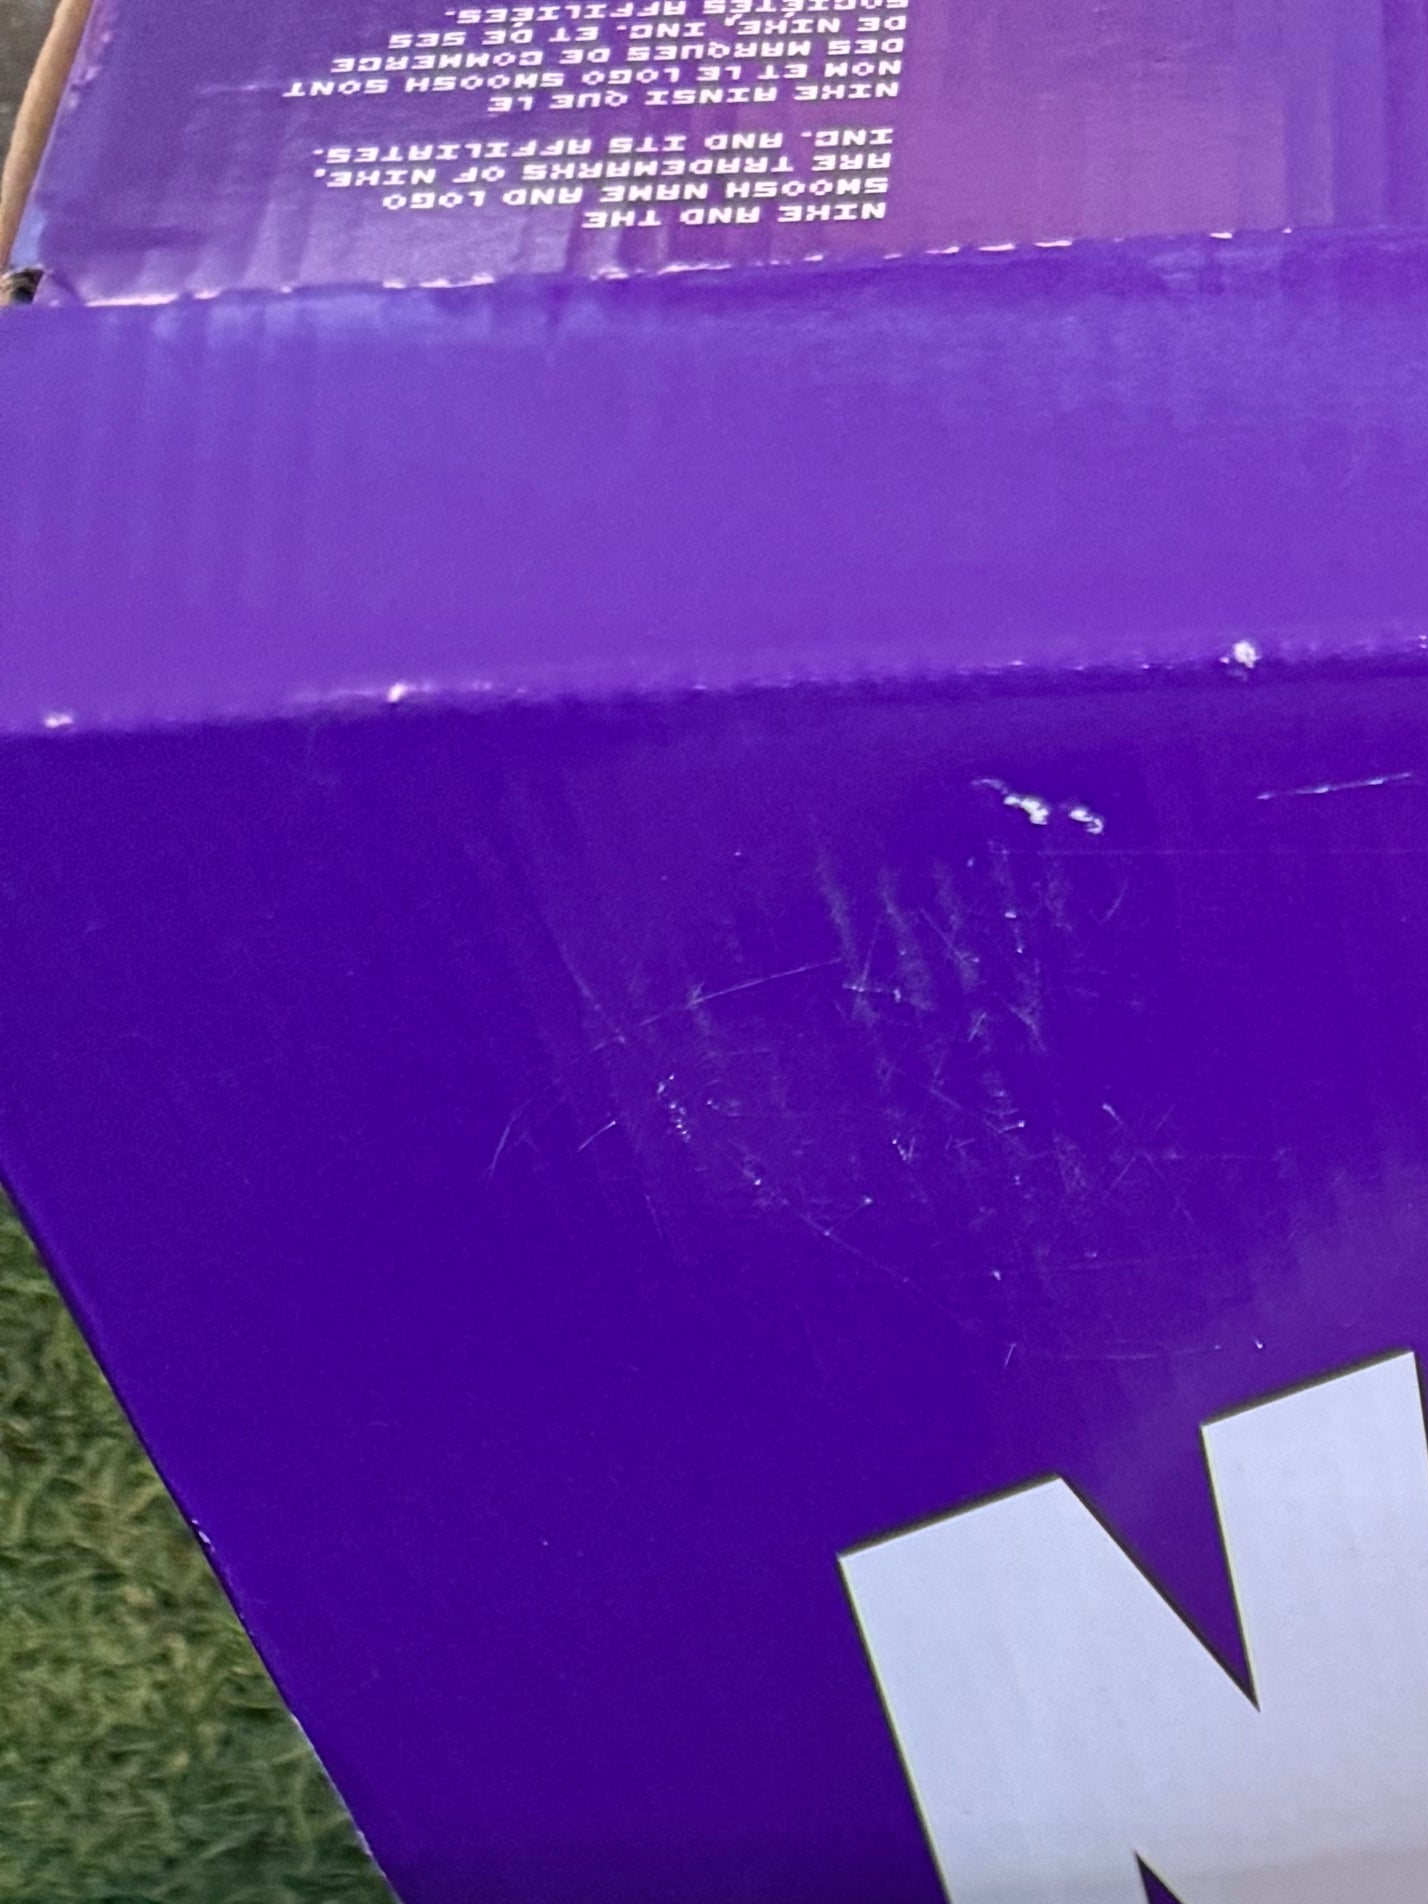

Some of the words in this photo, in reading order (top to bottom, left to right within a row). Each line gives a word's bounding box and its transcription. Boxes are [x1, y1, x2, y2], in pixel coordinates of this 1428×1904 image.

[444, 1, 686, 28] AFFILIÉES.
[858, 15, 906, 31] DE
[617, 22, 705, 38] INC.
[725, 16, 840, 34] NIKE,
[389, 32, 466, 48] SES
[483, 29, 533, 44] DE
[549, 26, 598, 42] ET
[627, 41, 810, 61] MARQUES
[828, 38, 904, 55] DES
[331, 51, 543, 72] COMMERCE
[560, 48, 610, 64] DE
[583, 67, 679, 85] LOGO
[698, 66, 741, 81] LE
[758, 63, 807, 79] ET
[825, 60, 902, 77] NOM
[283, 79, 388, 97] SONT
[405, 73, 564, 92] SWOOSH
[794, 82, 899, 100] NIKE
[487, 96, 533, 112] LE
[550, 92, 628, 109] QUE
[645, 87, 777, 105] AINSI
[610, 135, 686, 153] ITS
[705, 132, 783, 149] AND
[801, 128, 893, 146] INC.
[312, 139, 592, 164] AFFILIATES.
[523, 156, 793, 179] TRADEMARKS
[812, 152, 891, 171] ARE
[315, 170, 435, 187] NIKE,
[453, 167, 505, 182] OF
[600, 183, 708, 202] NAME
[726, 177, 888, 198] SWOOSH
[383, 193, 485, 209] LOGO
[503, 189, 582, 205] AND
[582, 211, 661, 228] THE
[680, 207, 760, 224] AND
[778, 202, 886, 222] NIKE
